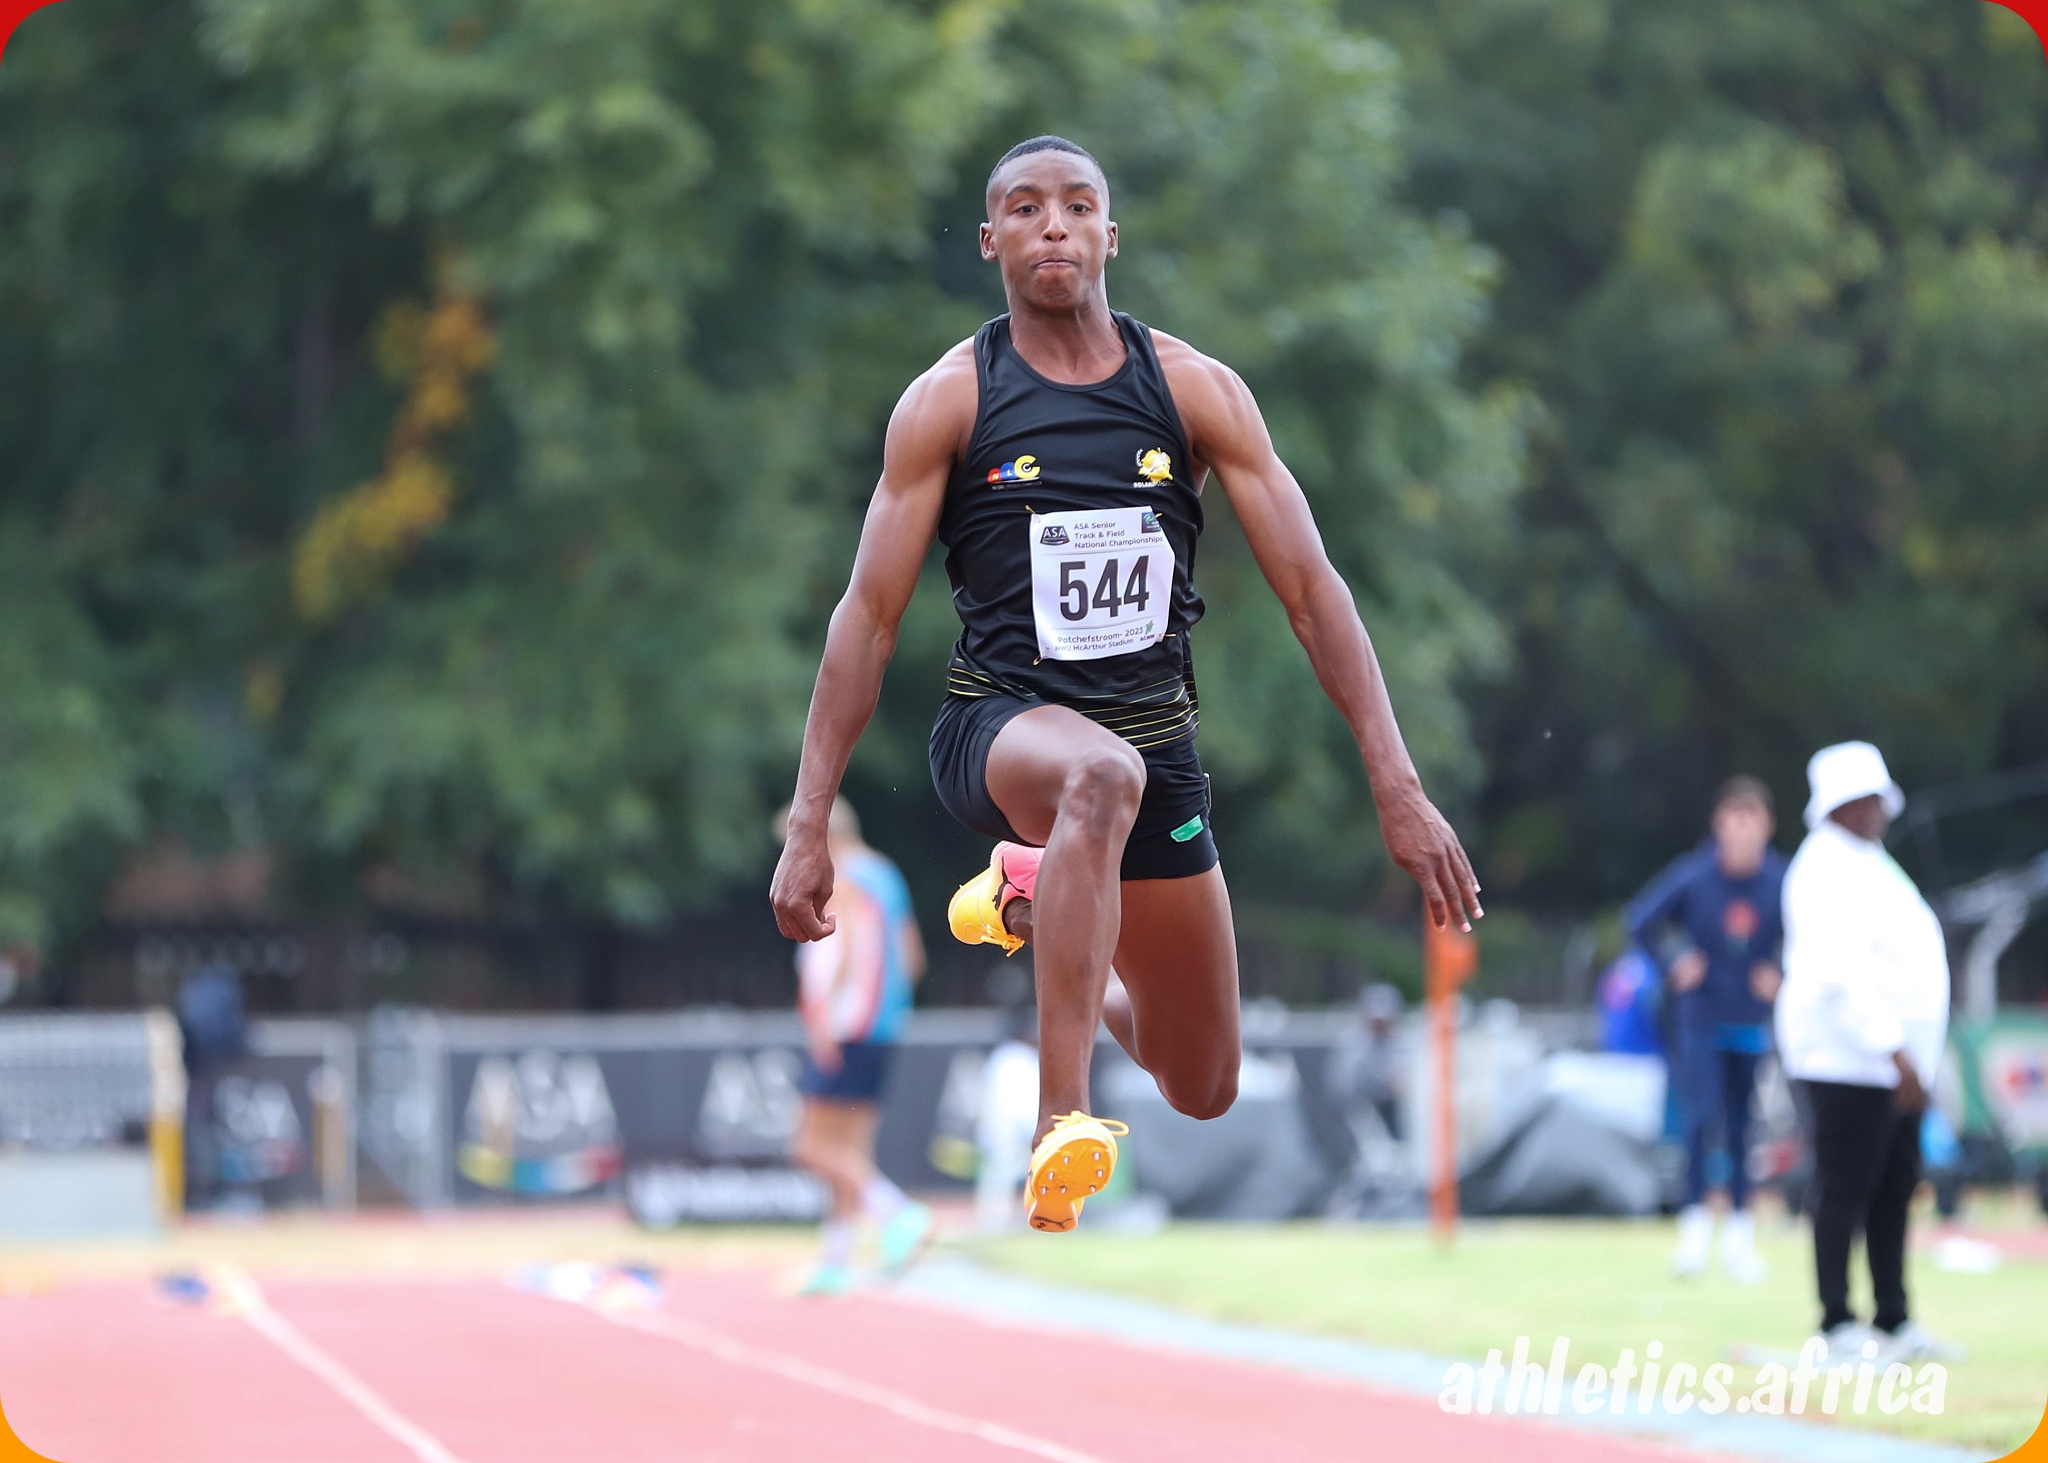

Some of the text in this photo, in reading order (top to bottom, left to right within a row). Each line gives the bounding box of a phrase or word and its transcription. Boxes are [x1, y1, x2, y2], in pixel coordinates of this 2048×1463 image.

[1074, 521, 1116, 530] ASA Senior
[1043, 526, 1067, 538] ASA
[1074, 532, 1096, 540] Track
[1106, 530, 1125, 538] Field
[1074, 536, 1163, 549] National Championships
[1060, 555, 1150, 621] 544
[1125, 626, 1144, 637] 2023
[1073, 642, 1107, 651] McArthur
[1108, 638, 1134, 648] Stadium
